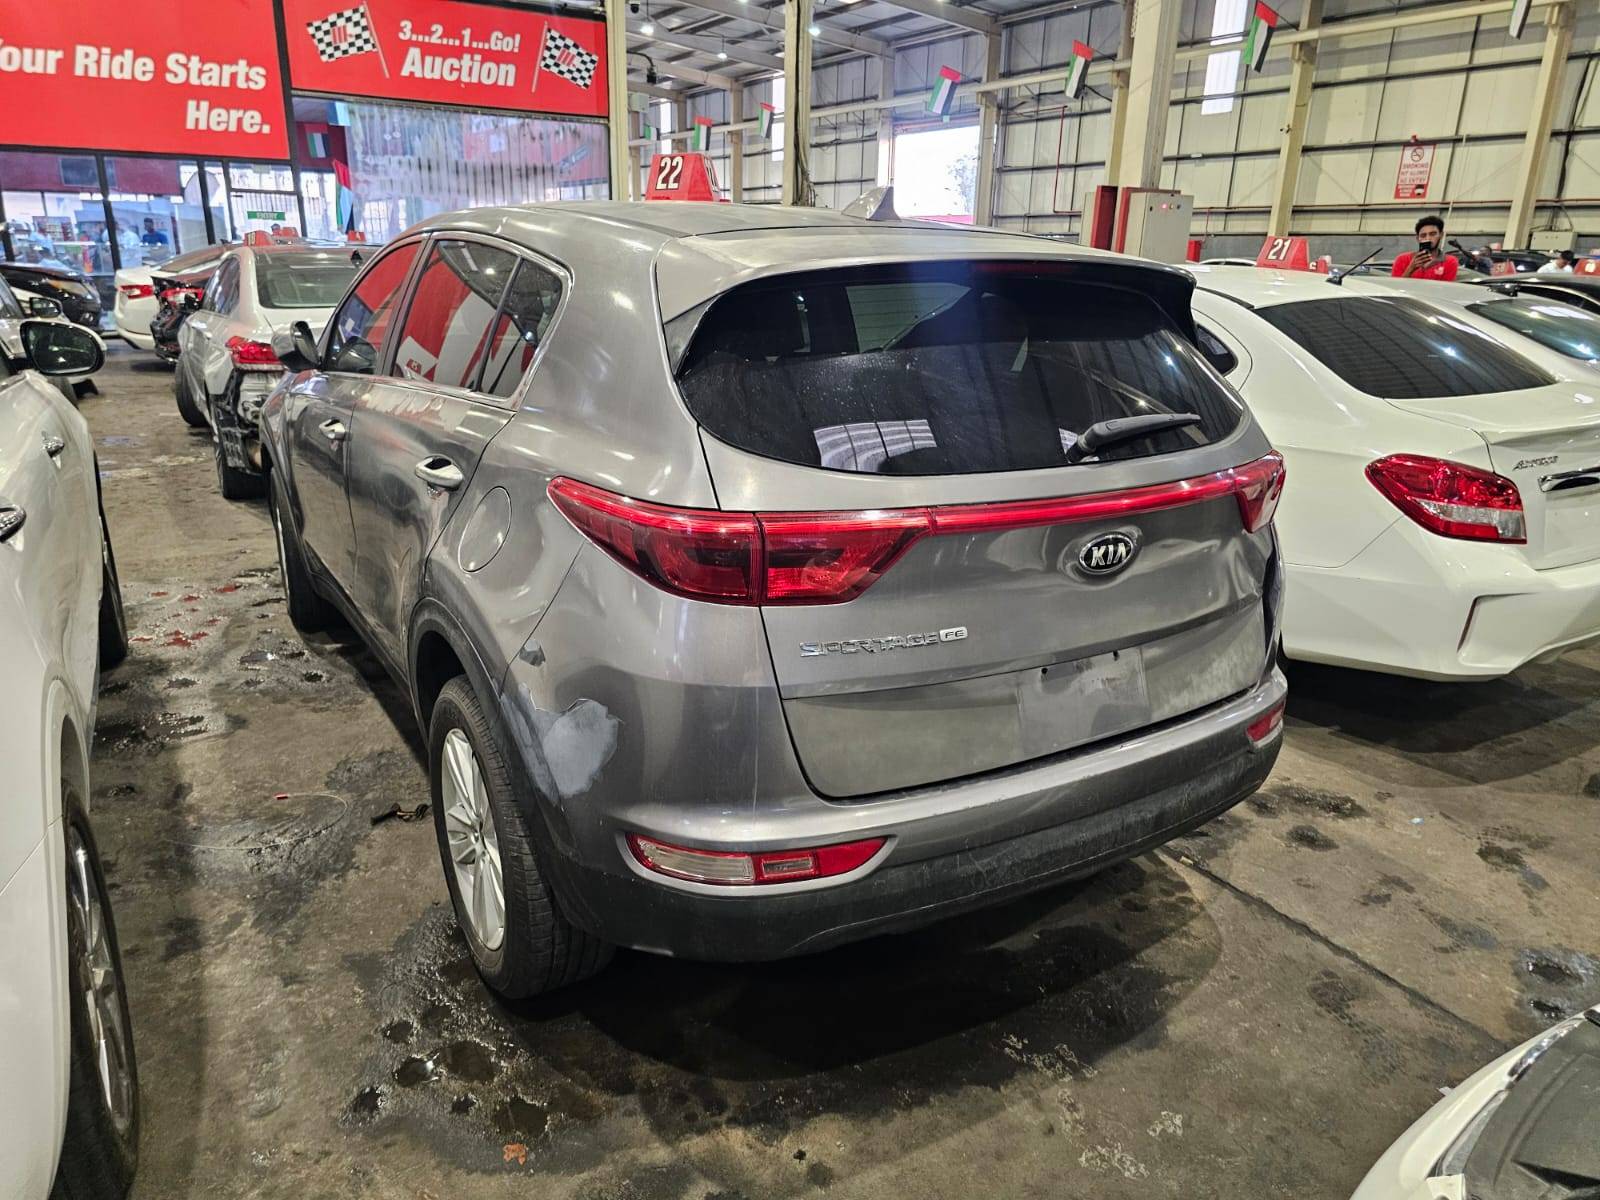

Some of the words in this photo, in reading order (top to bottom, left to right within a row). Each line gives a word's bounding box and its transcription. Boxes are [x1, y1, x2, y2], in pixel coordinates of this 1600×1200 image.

[399, 20, 520, 52] 3...2...1...Go!
[74, 44, 155, 81] Ride
[165, 53, 267, 90] Starts
[400, 47, 517, 87] Auction
[185, 99, 271, 134] Here.
[655, 156, 684, 190] 22
[1267, 238, 1292, 260] 21
[1090, 543, 1127, 567] KIA
[799, 632, 939, 657] SPORTAGE
[944, 629, 967, 640] FE
